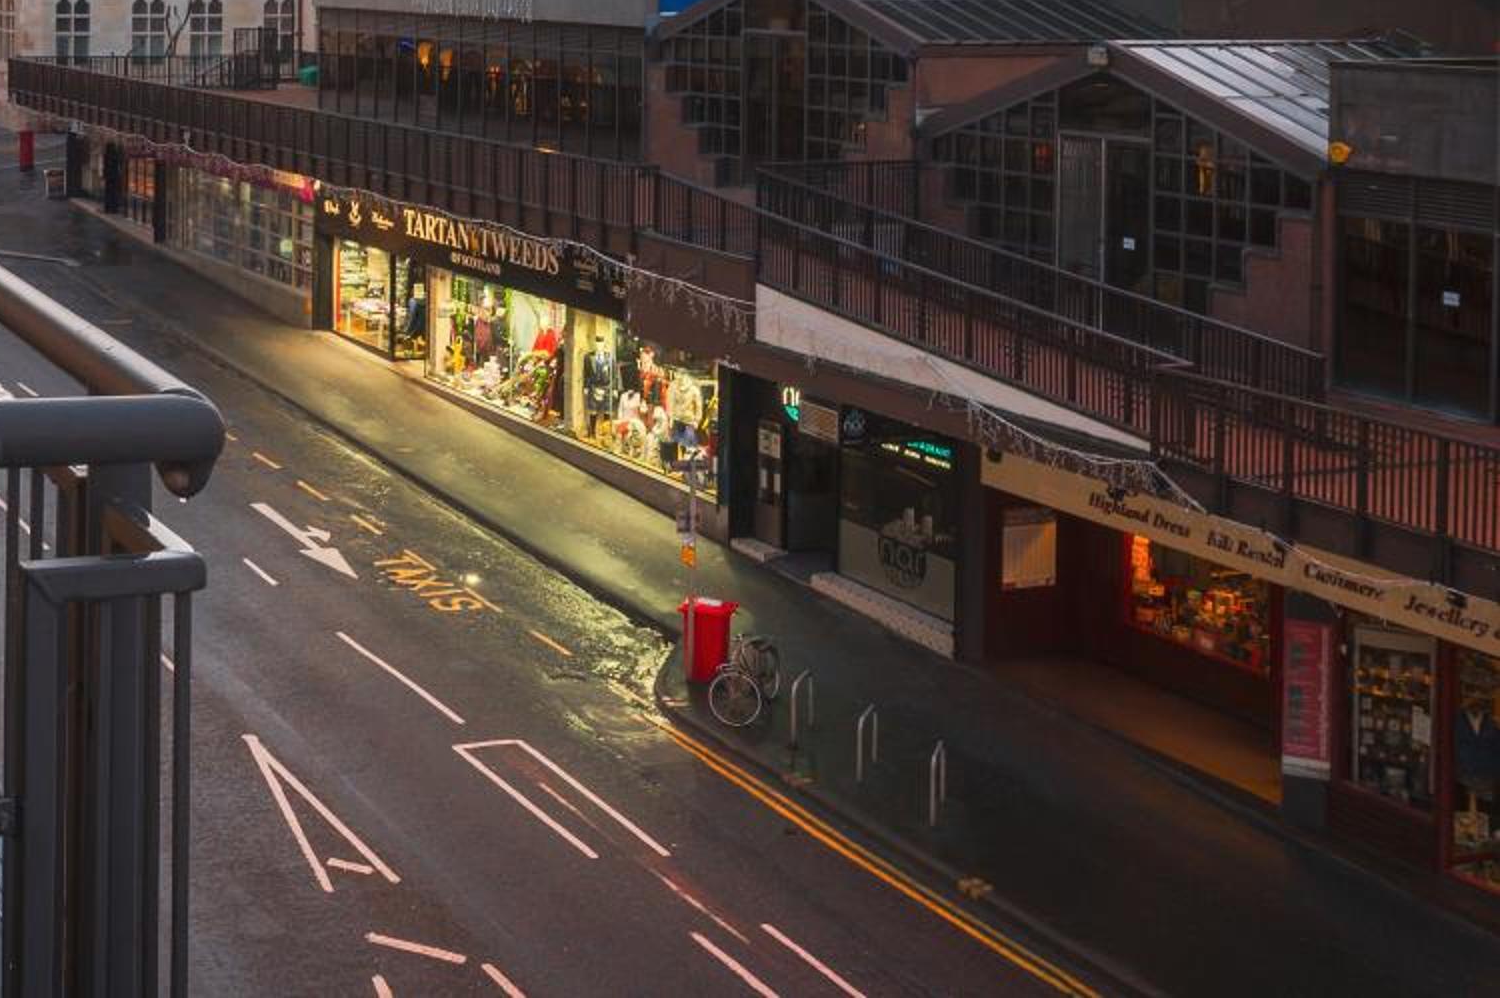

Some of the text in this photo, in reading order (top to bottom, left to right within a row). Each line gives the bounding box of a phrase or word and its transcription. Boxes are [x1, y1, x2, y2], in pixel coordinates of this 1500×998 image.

[403, 209, 469, 250] TARTAN
[480, 228, 560, 275] TWEEDS
[374, 553, 482, 611] TAXIS
[1088, 492, 1150, 524] Highland
[1152, 514, 1190, 538] Dress
[1403, 596, 1490, 638] Jewellery
